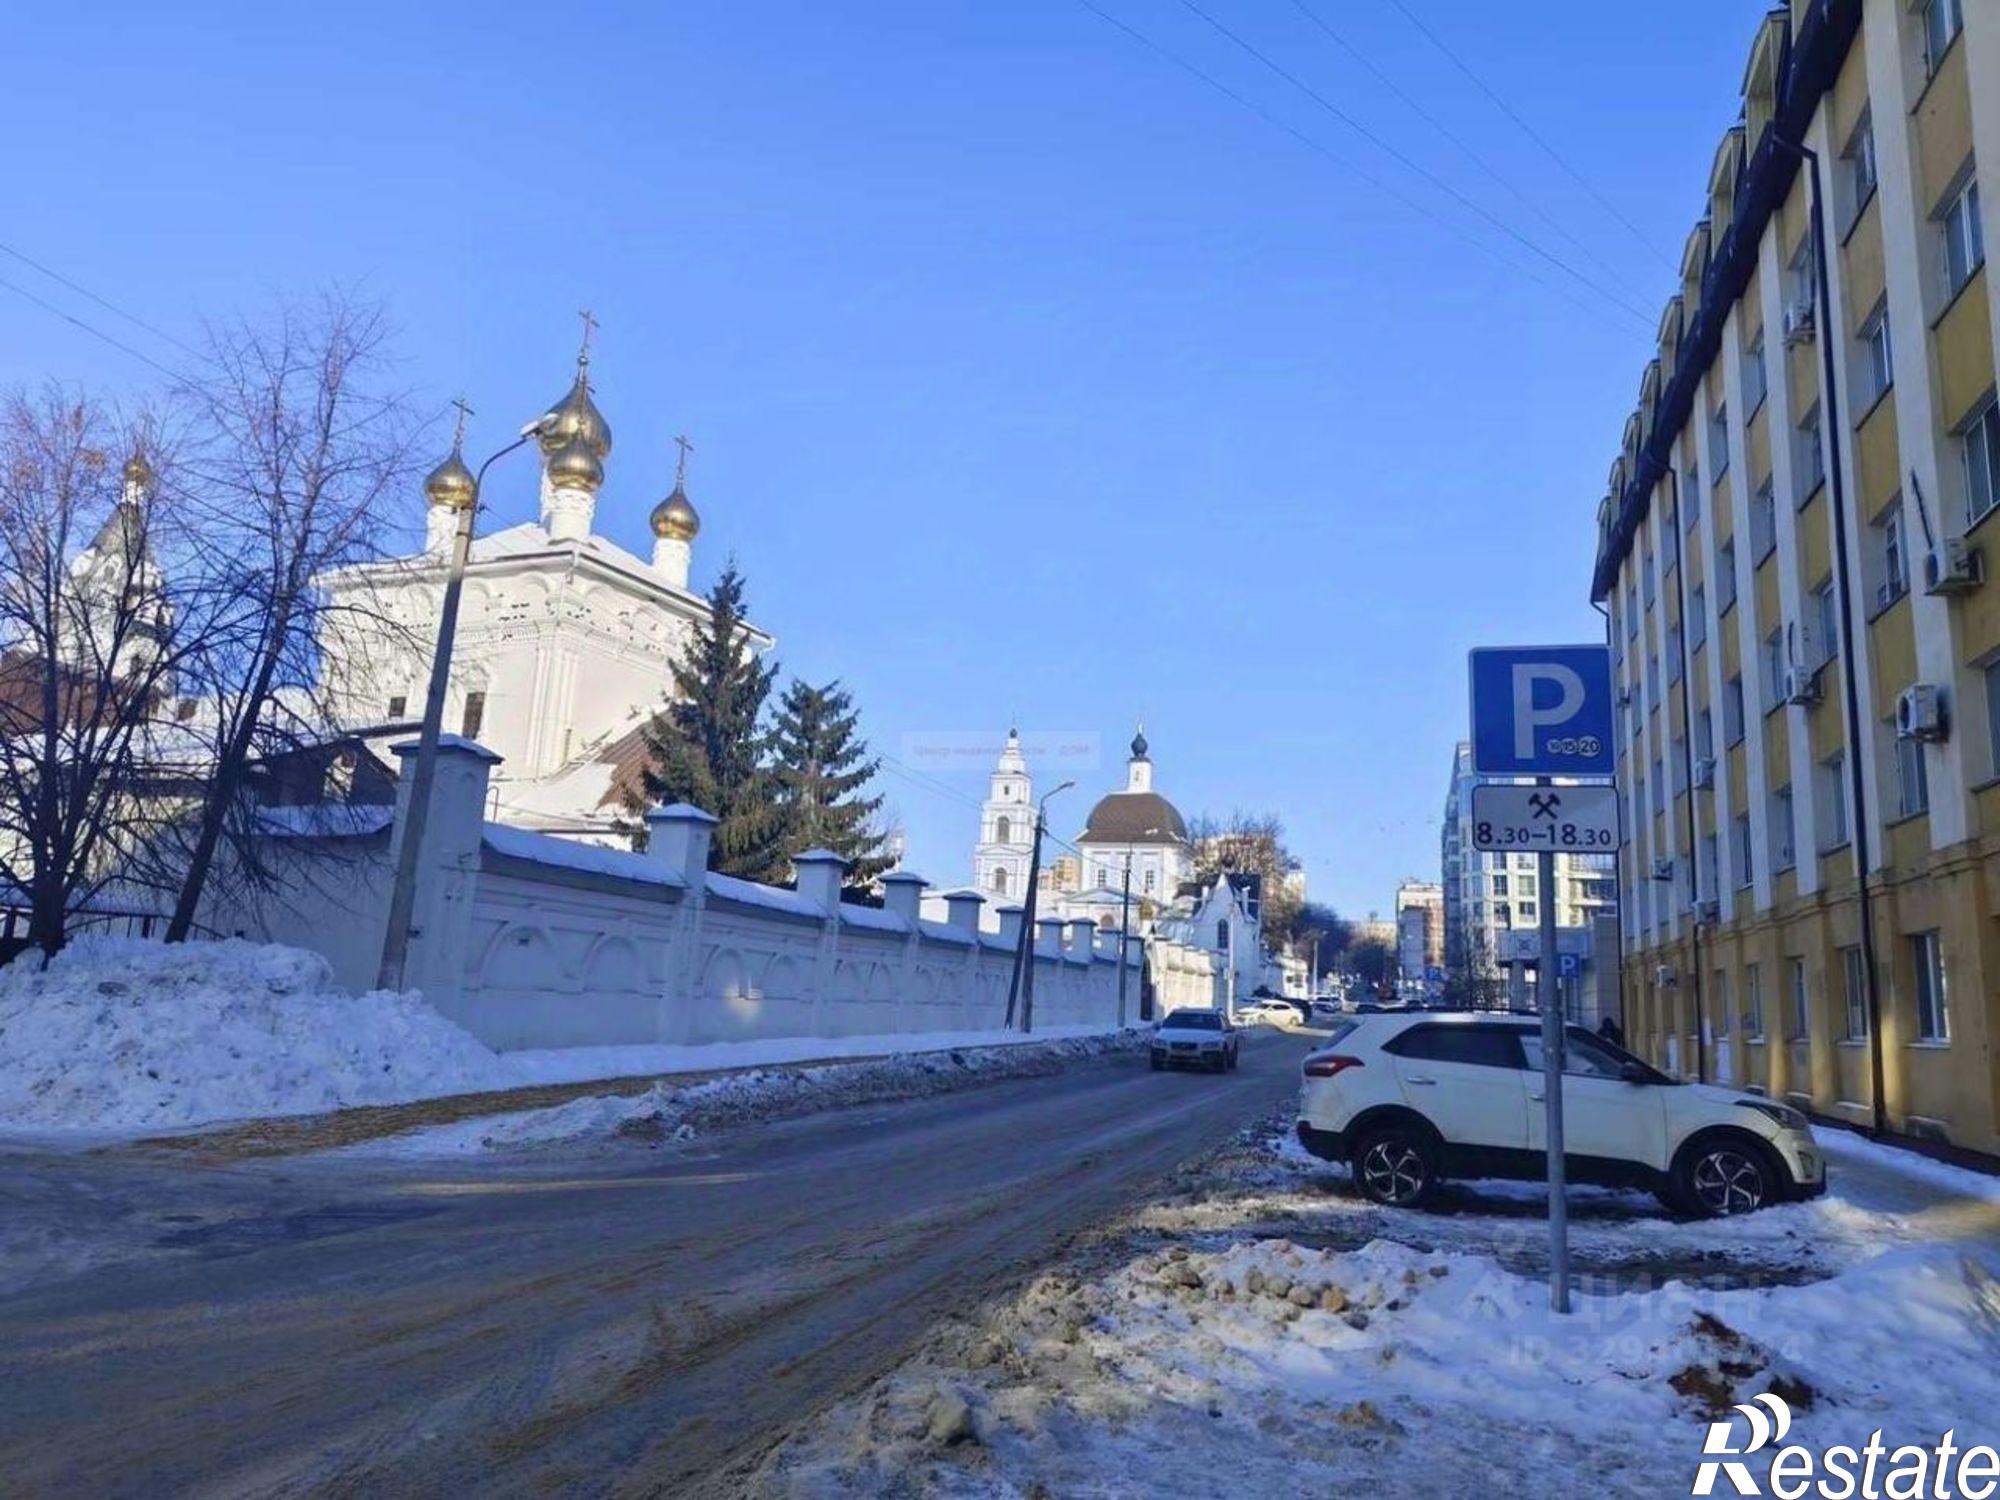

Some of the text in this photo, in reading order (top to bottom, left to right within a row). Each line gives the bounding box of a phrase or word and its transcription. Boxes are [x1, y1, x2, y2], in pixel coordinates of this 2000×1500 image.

[1512, 663, 1585, 759] P
[1580, 739, 1599, 753] 20
[1477, 821, 1611, 846] 8.30-18.30
